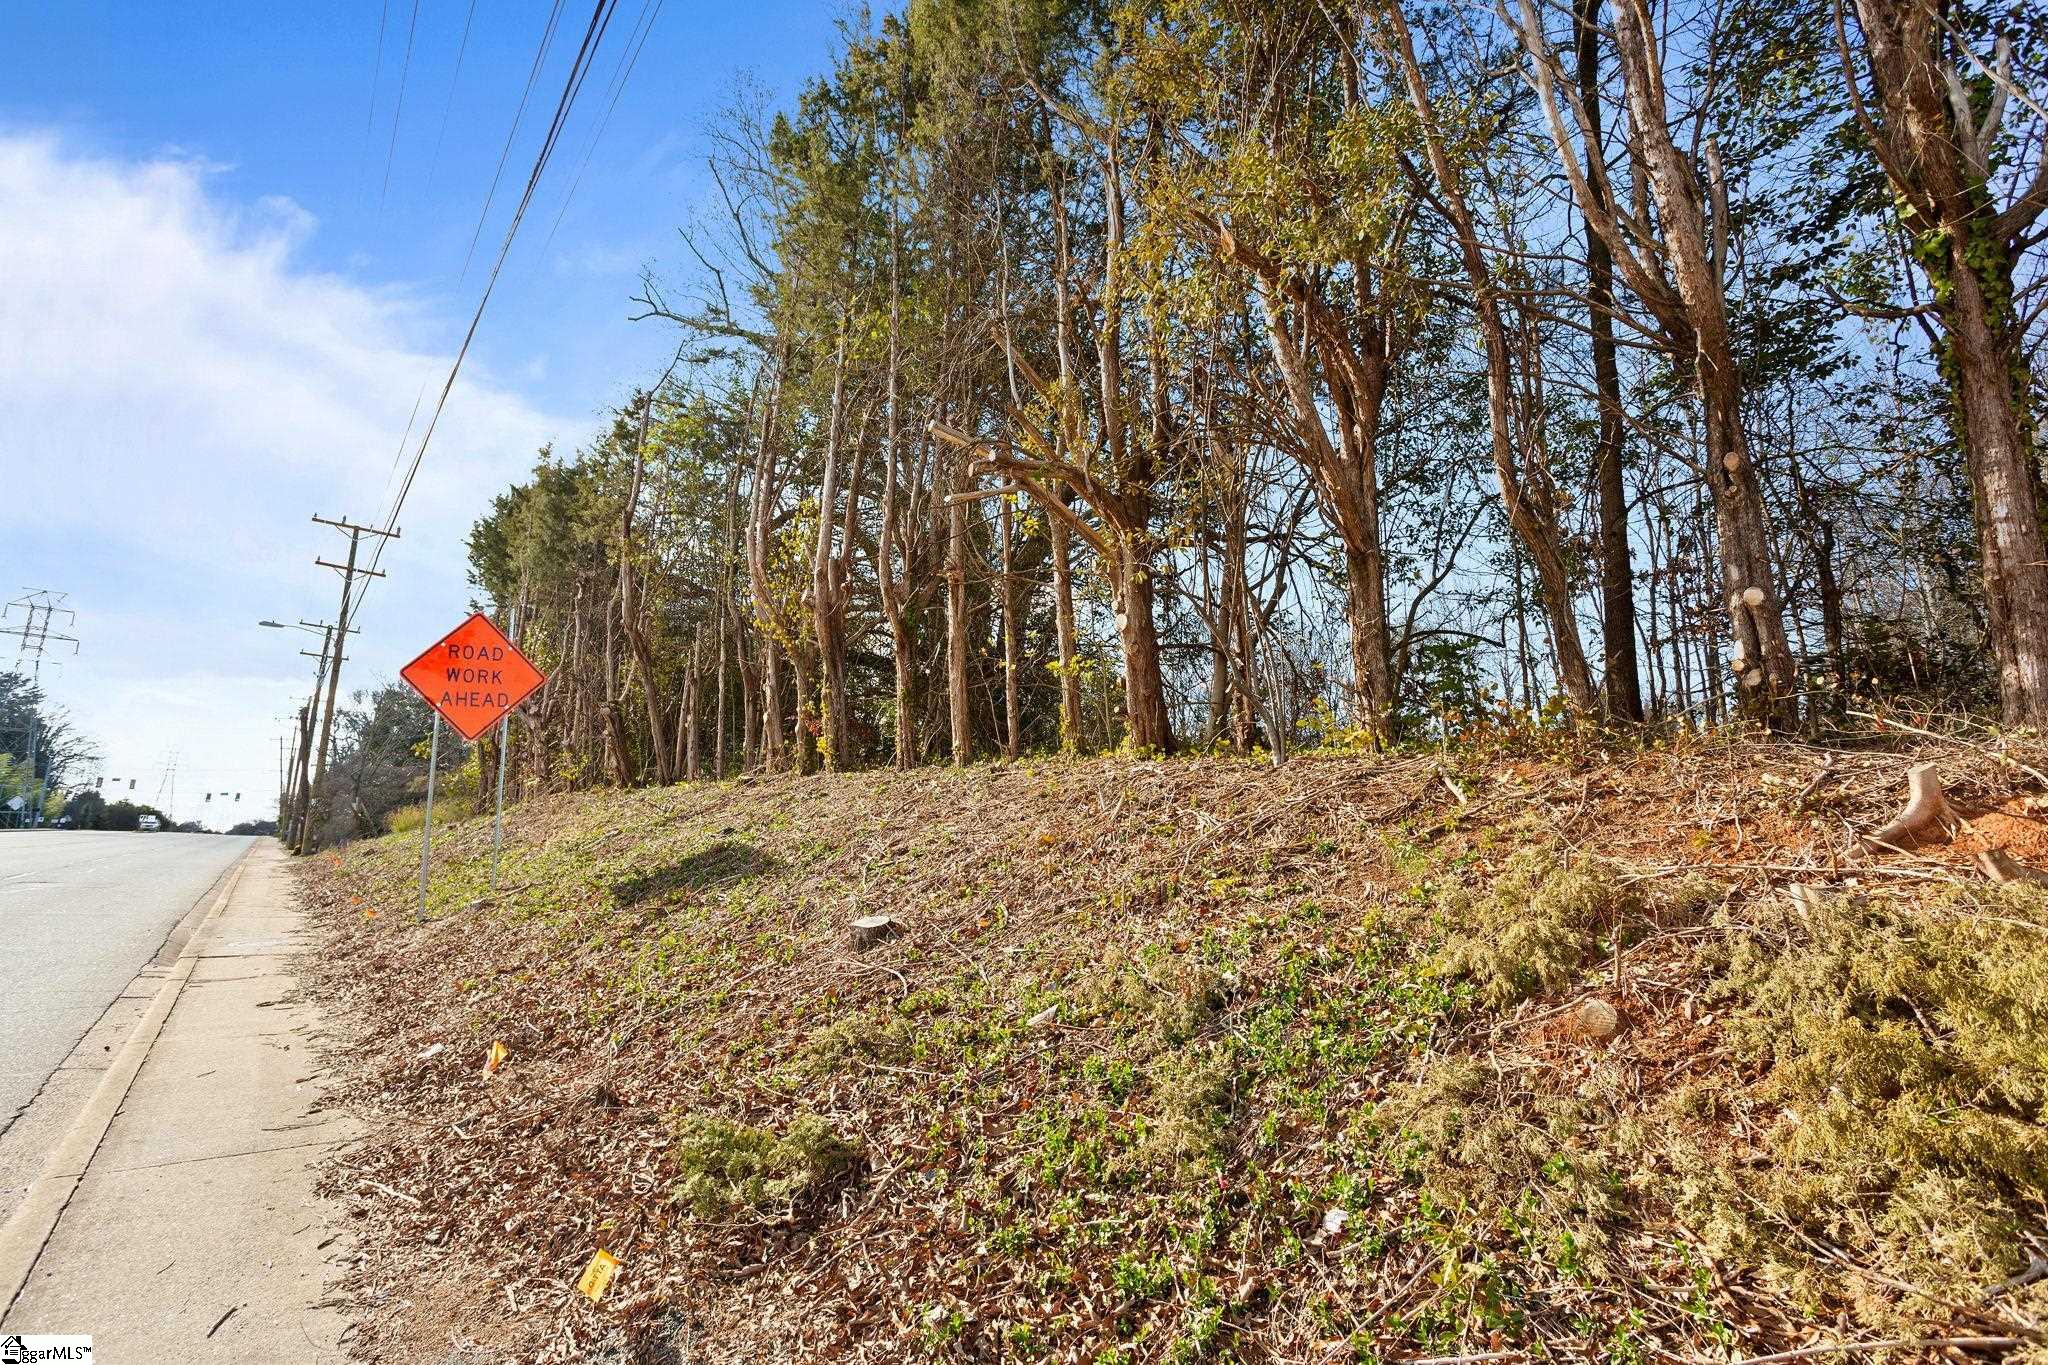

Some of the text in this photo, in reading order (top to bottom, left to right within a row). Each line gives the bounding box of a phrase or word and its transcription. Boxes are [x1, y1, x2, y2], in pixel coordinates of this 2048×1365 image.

[448, 644, 504, 661] ROAD
[446, 667, 503, 684] WORK
[440, 691, 509, 708] AHEAD
